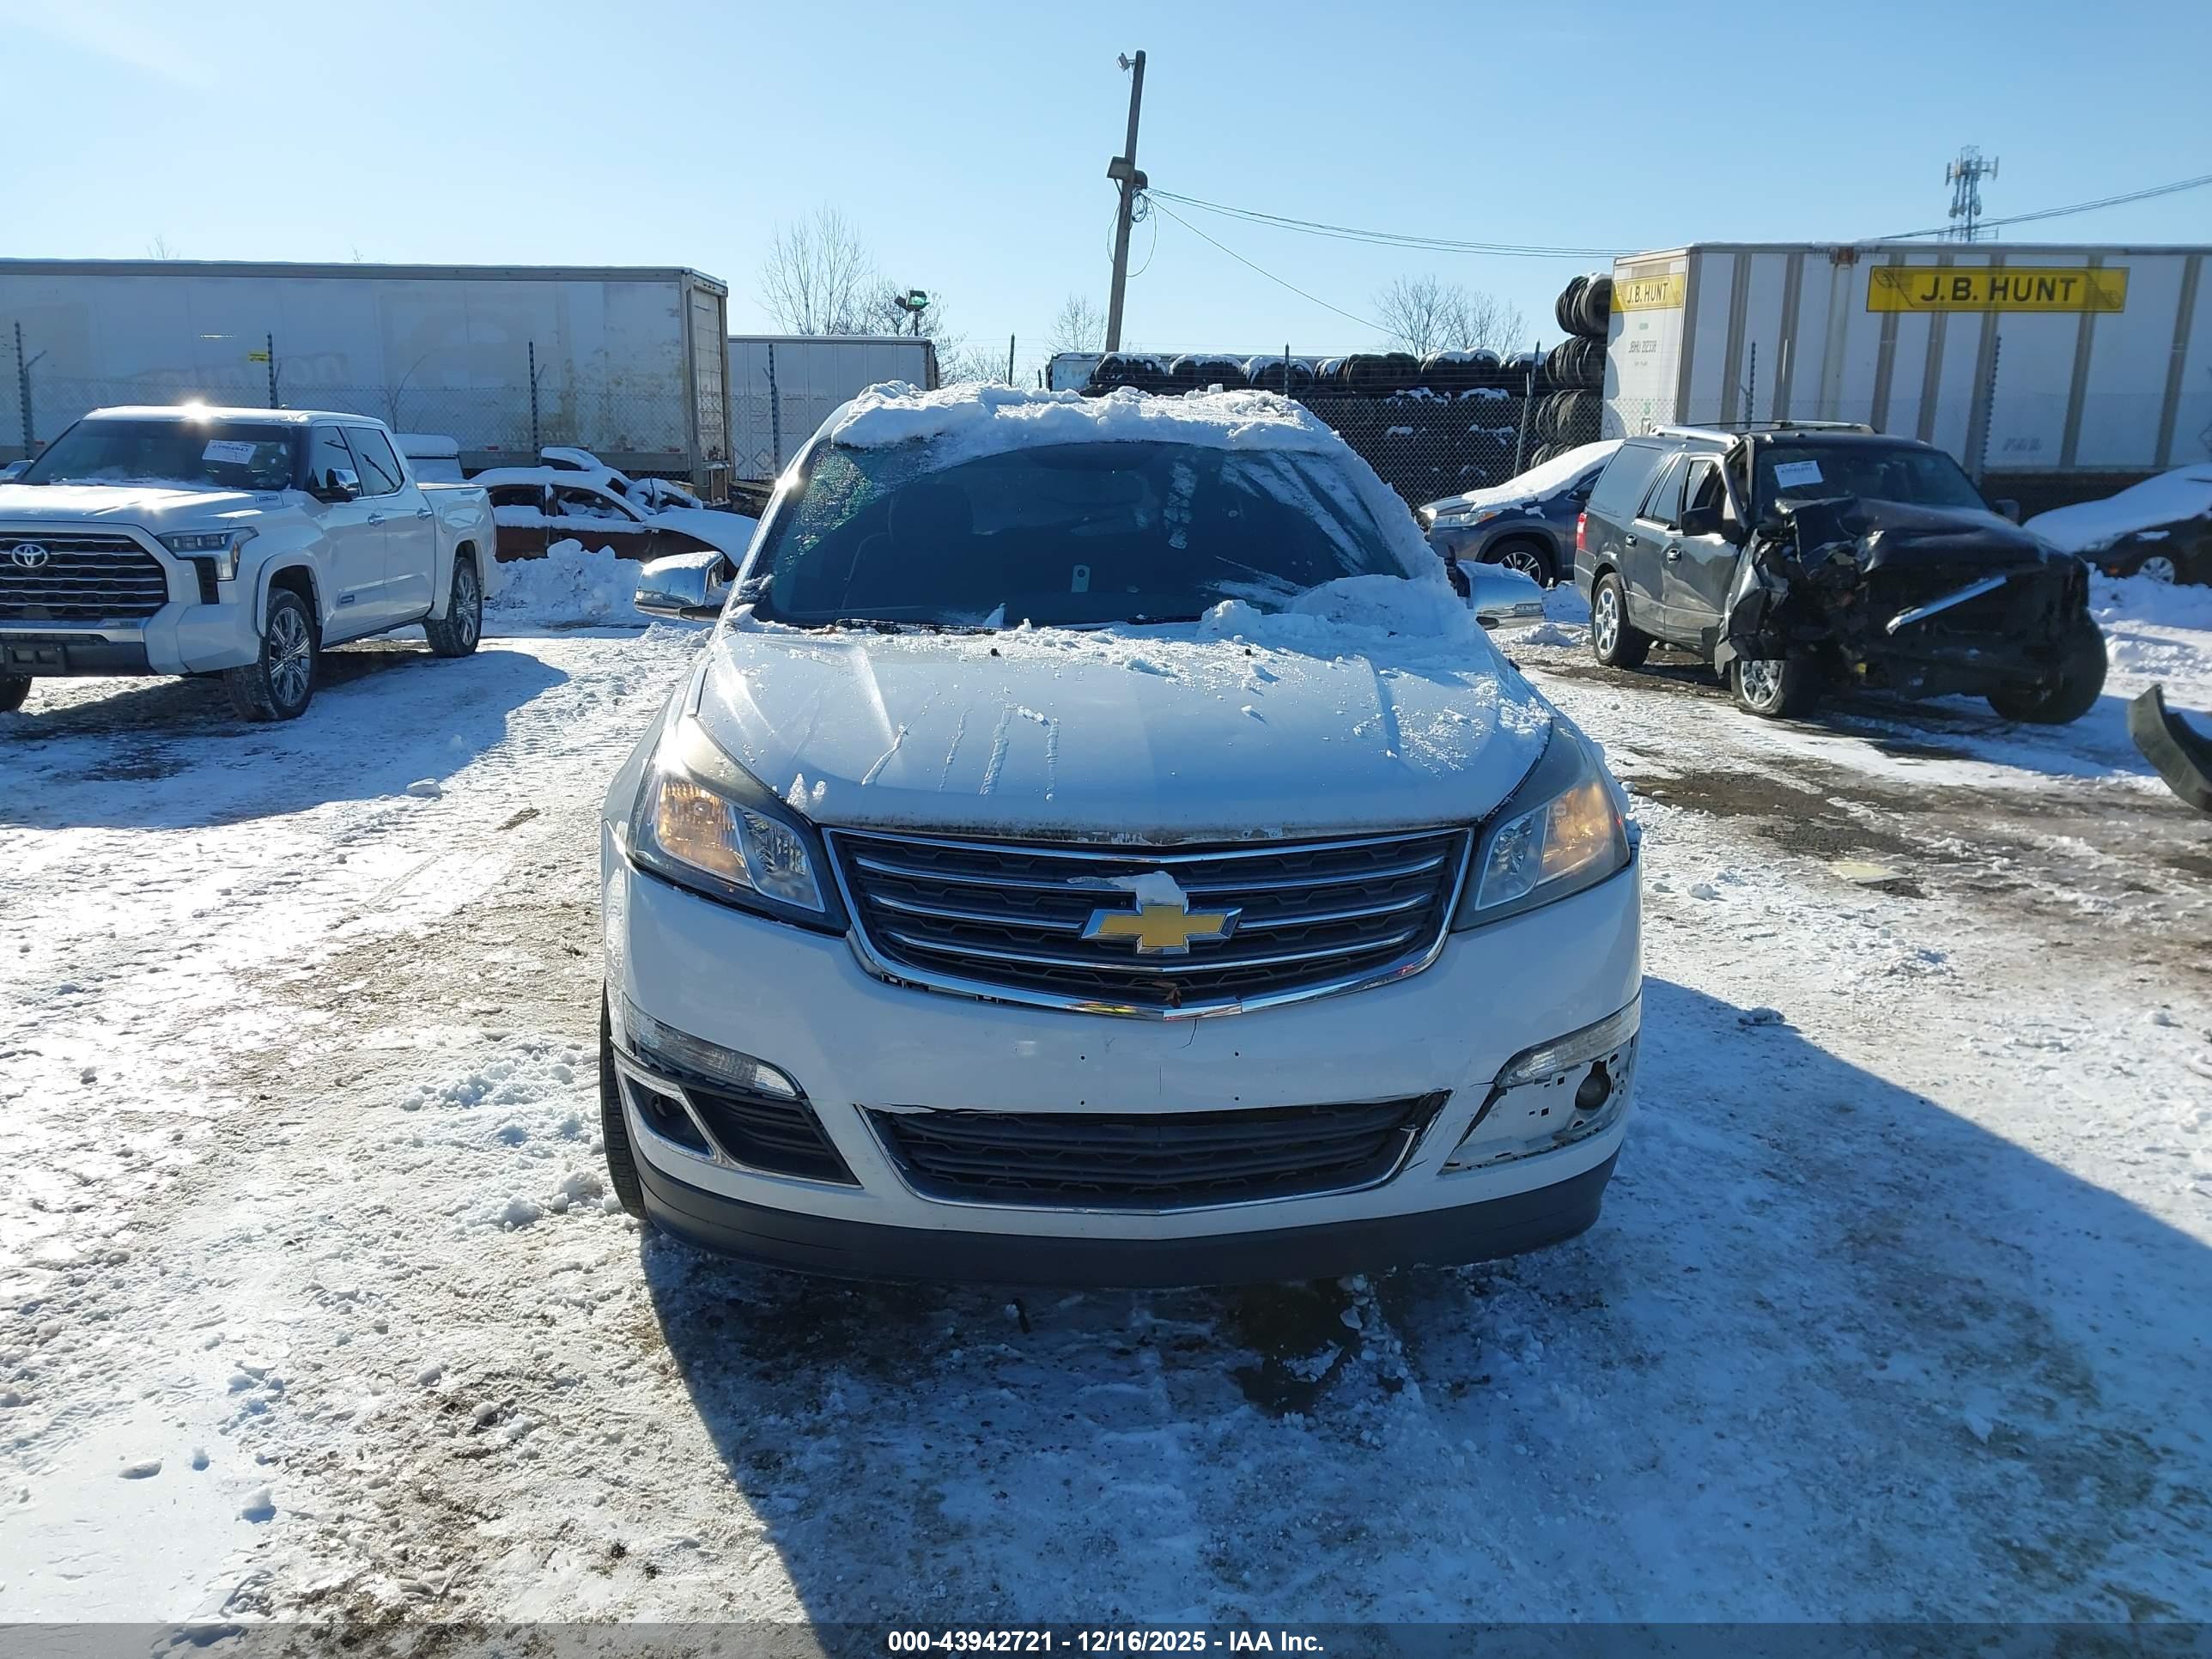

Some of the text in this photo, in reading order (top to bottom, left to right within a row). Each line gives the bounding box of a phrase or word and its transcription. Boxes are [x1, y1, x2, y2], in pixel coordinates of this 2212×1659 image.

[1644, 282, 1668, 302] HUNT
[1920, 276, 2078, 301] J.B. HUNT
